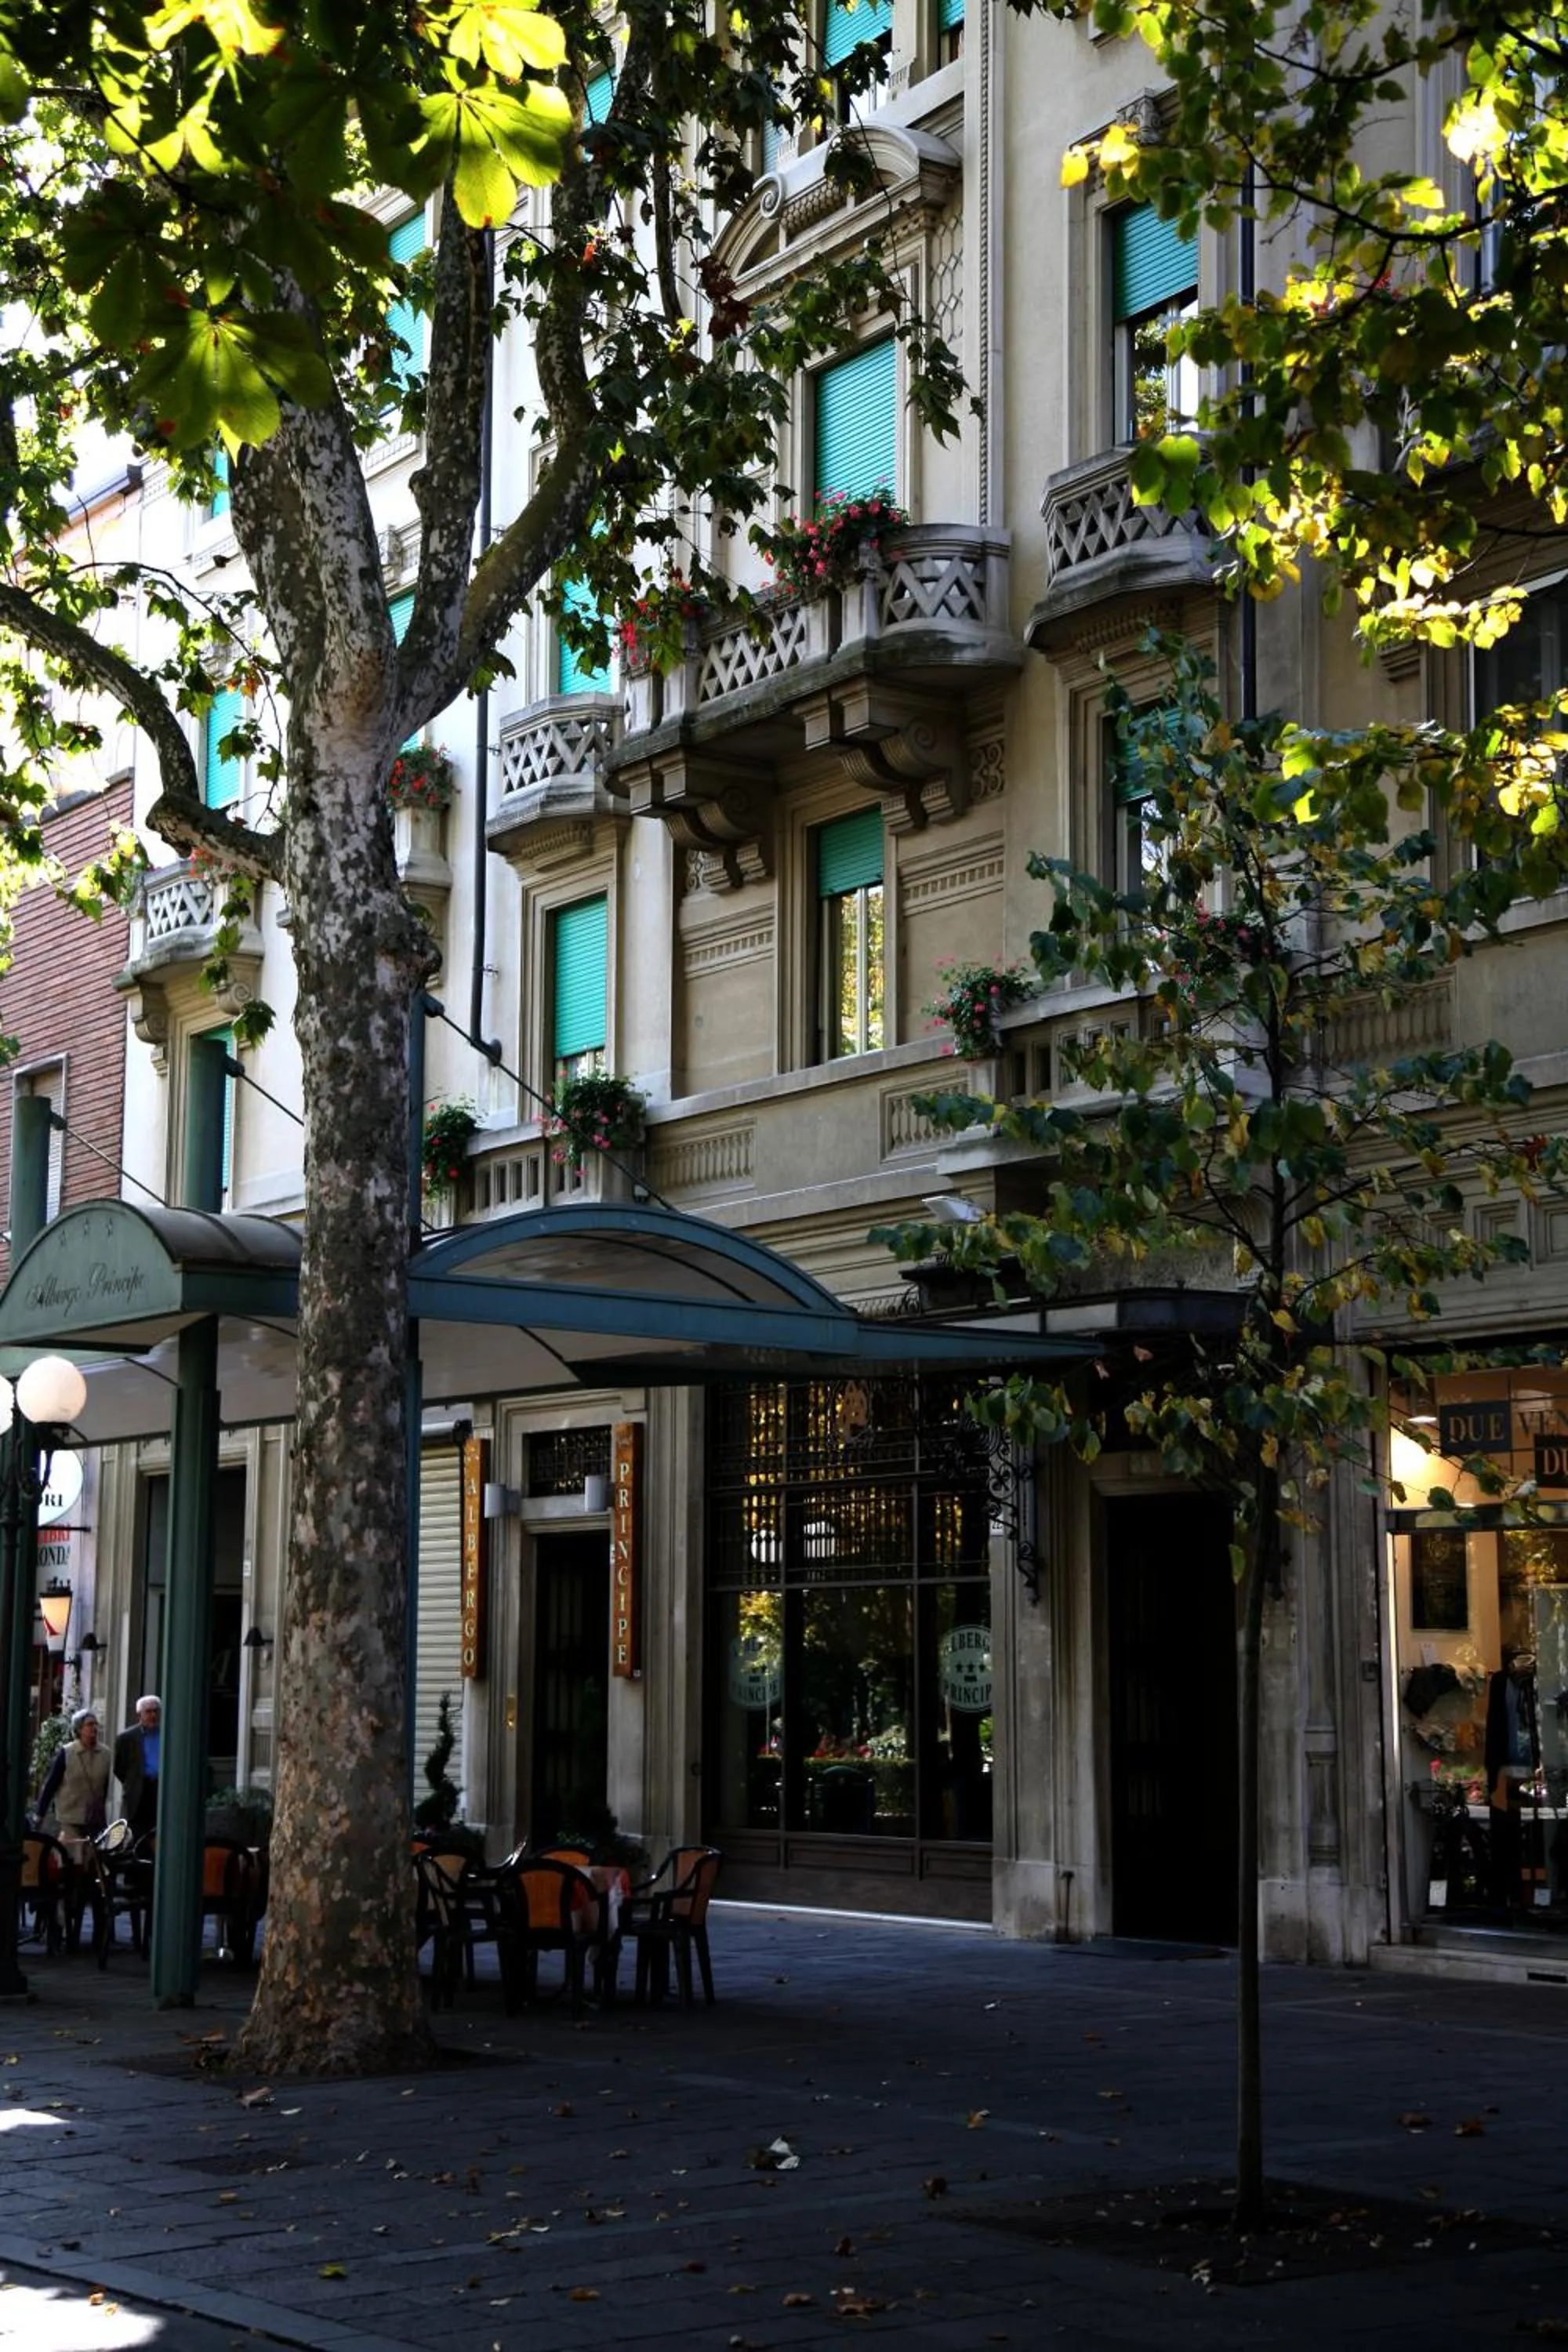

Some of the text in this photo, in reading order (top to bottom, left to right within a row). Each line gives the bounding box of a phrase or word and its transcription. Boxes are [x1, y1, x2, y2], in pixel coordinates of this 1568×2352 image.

[1447, 1412, 1505, 1444] DUE
[463, 1479, 477, 1665] ALBERGO
[616, 1461, 630, 1665] PRINCIPE
